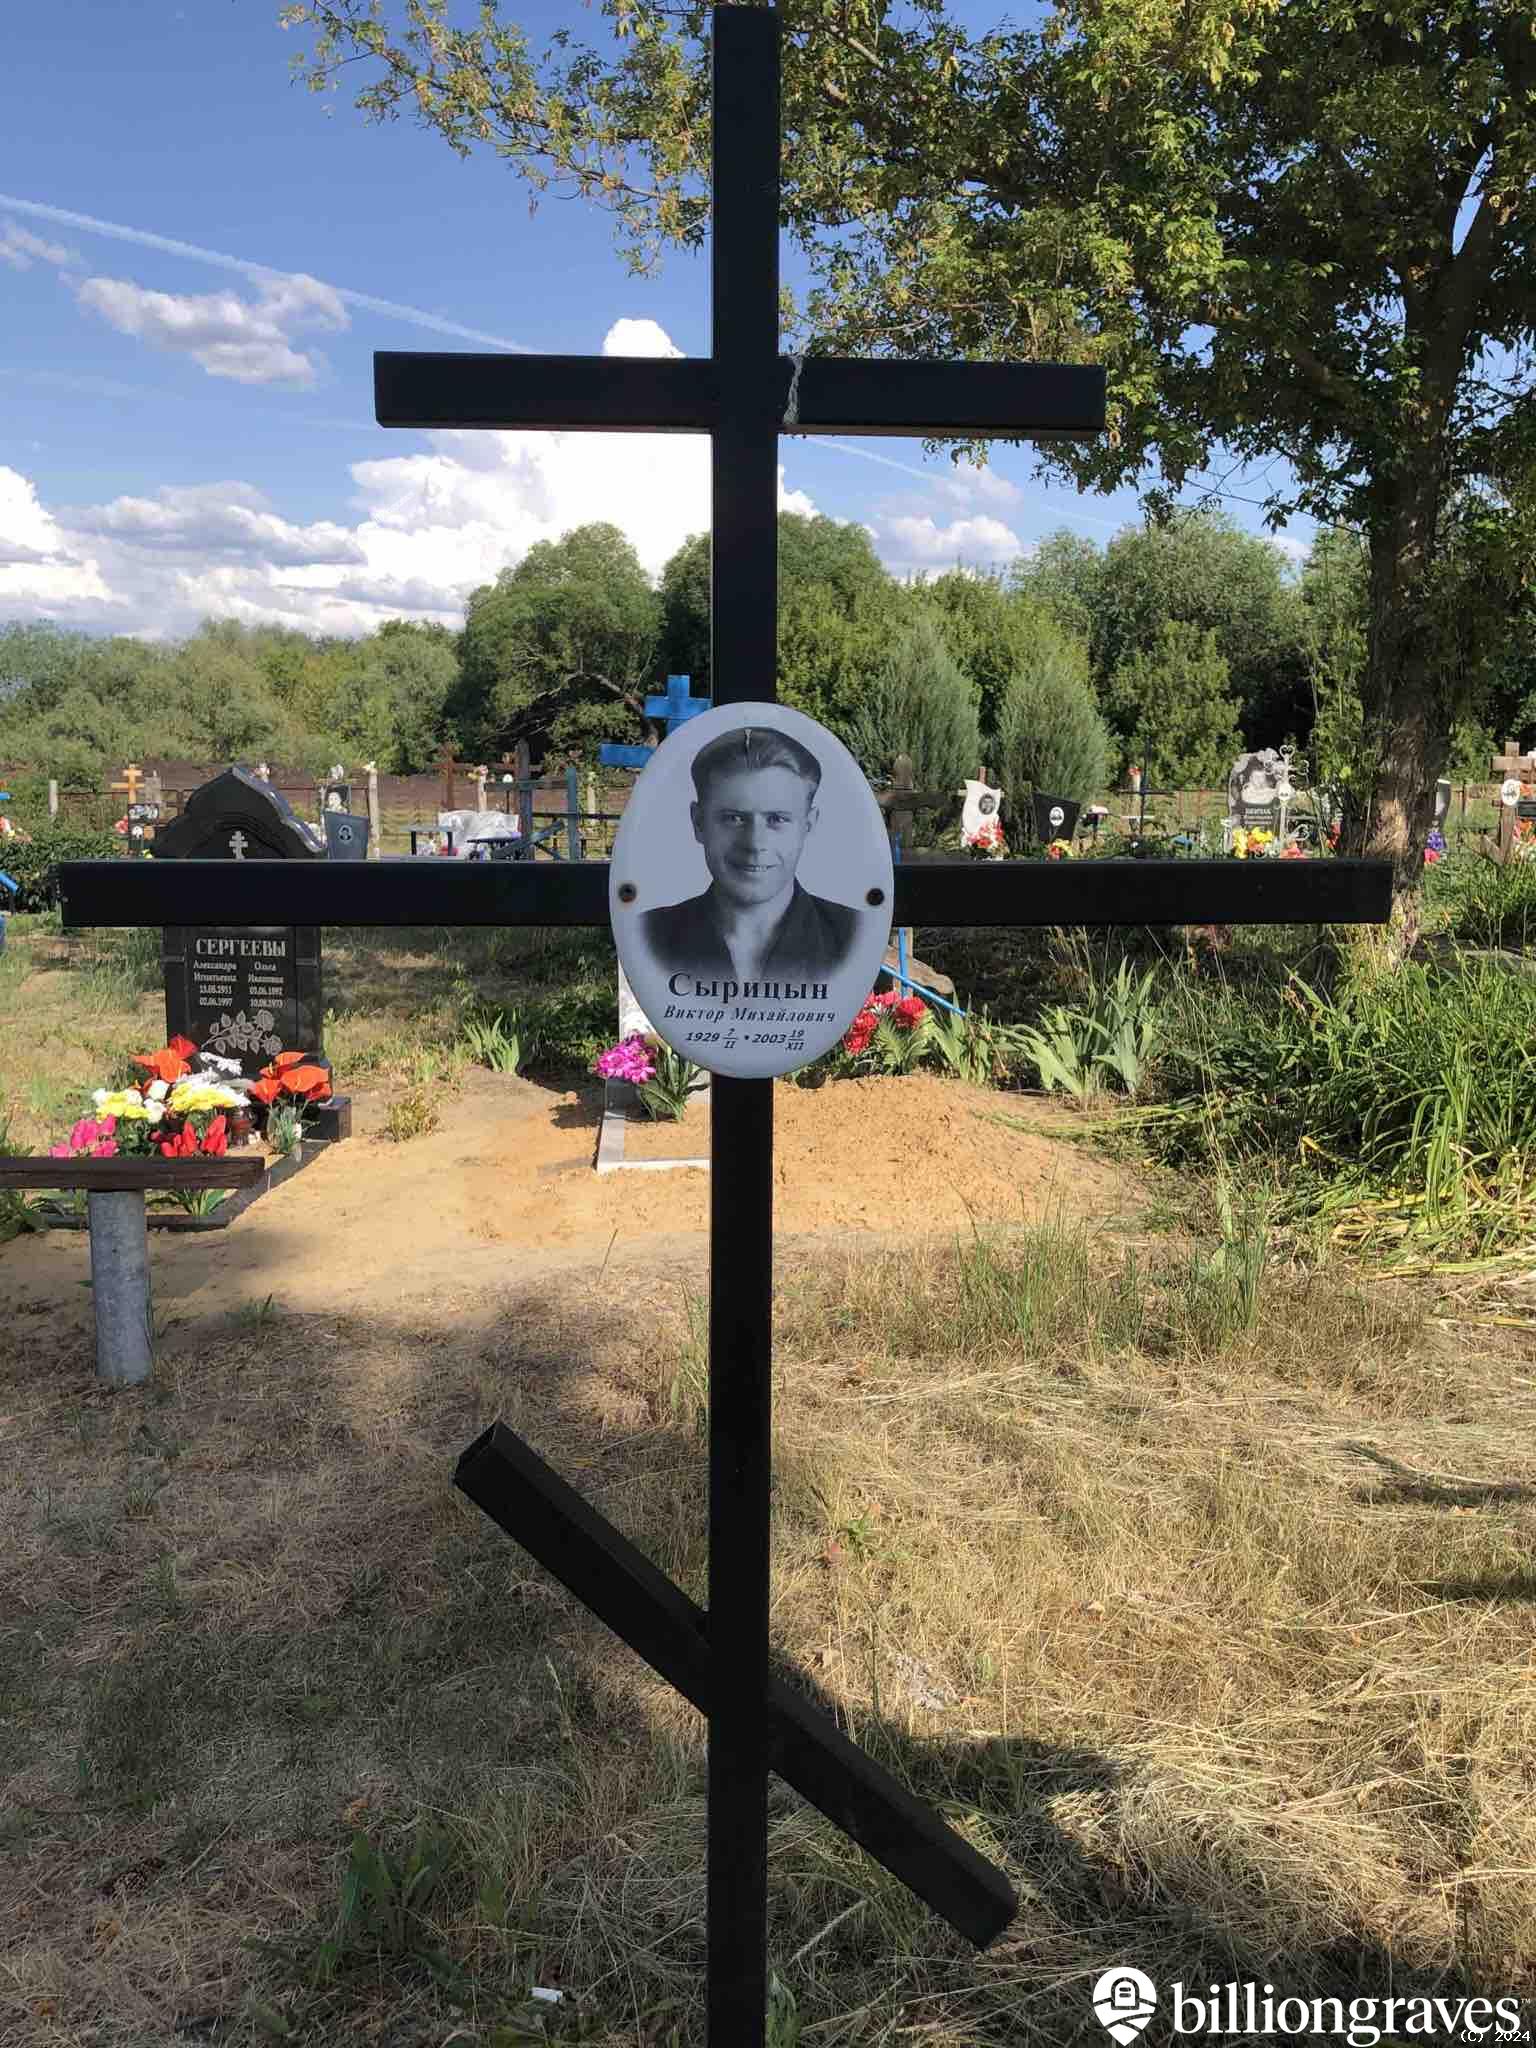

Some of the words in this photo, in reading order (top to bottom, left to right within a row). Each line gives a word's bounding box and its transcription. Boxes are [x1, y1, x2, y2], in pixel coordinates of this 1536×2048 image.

[195, 938, 286, 957] СЕРГЕЕВЫ
[668, 972, 828, 1003] Сырицын
[664, 1005, 725, 1023] Виктор
[731, 1007, 836, 1023] Михайлович
[685, 1032, 720, 1042] 1929
[751, 1033, 787, 1044] 2003
